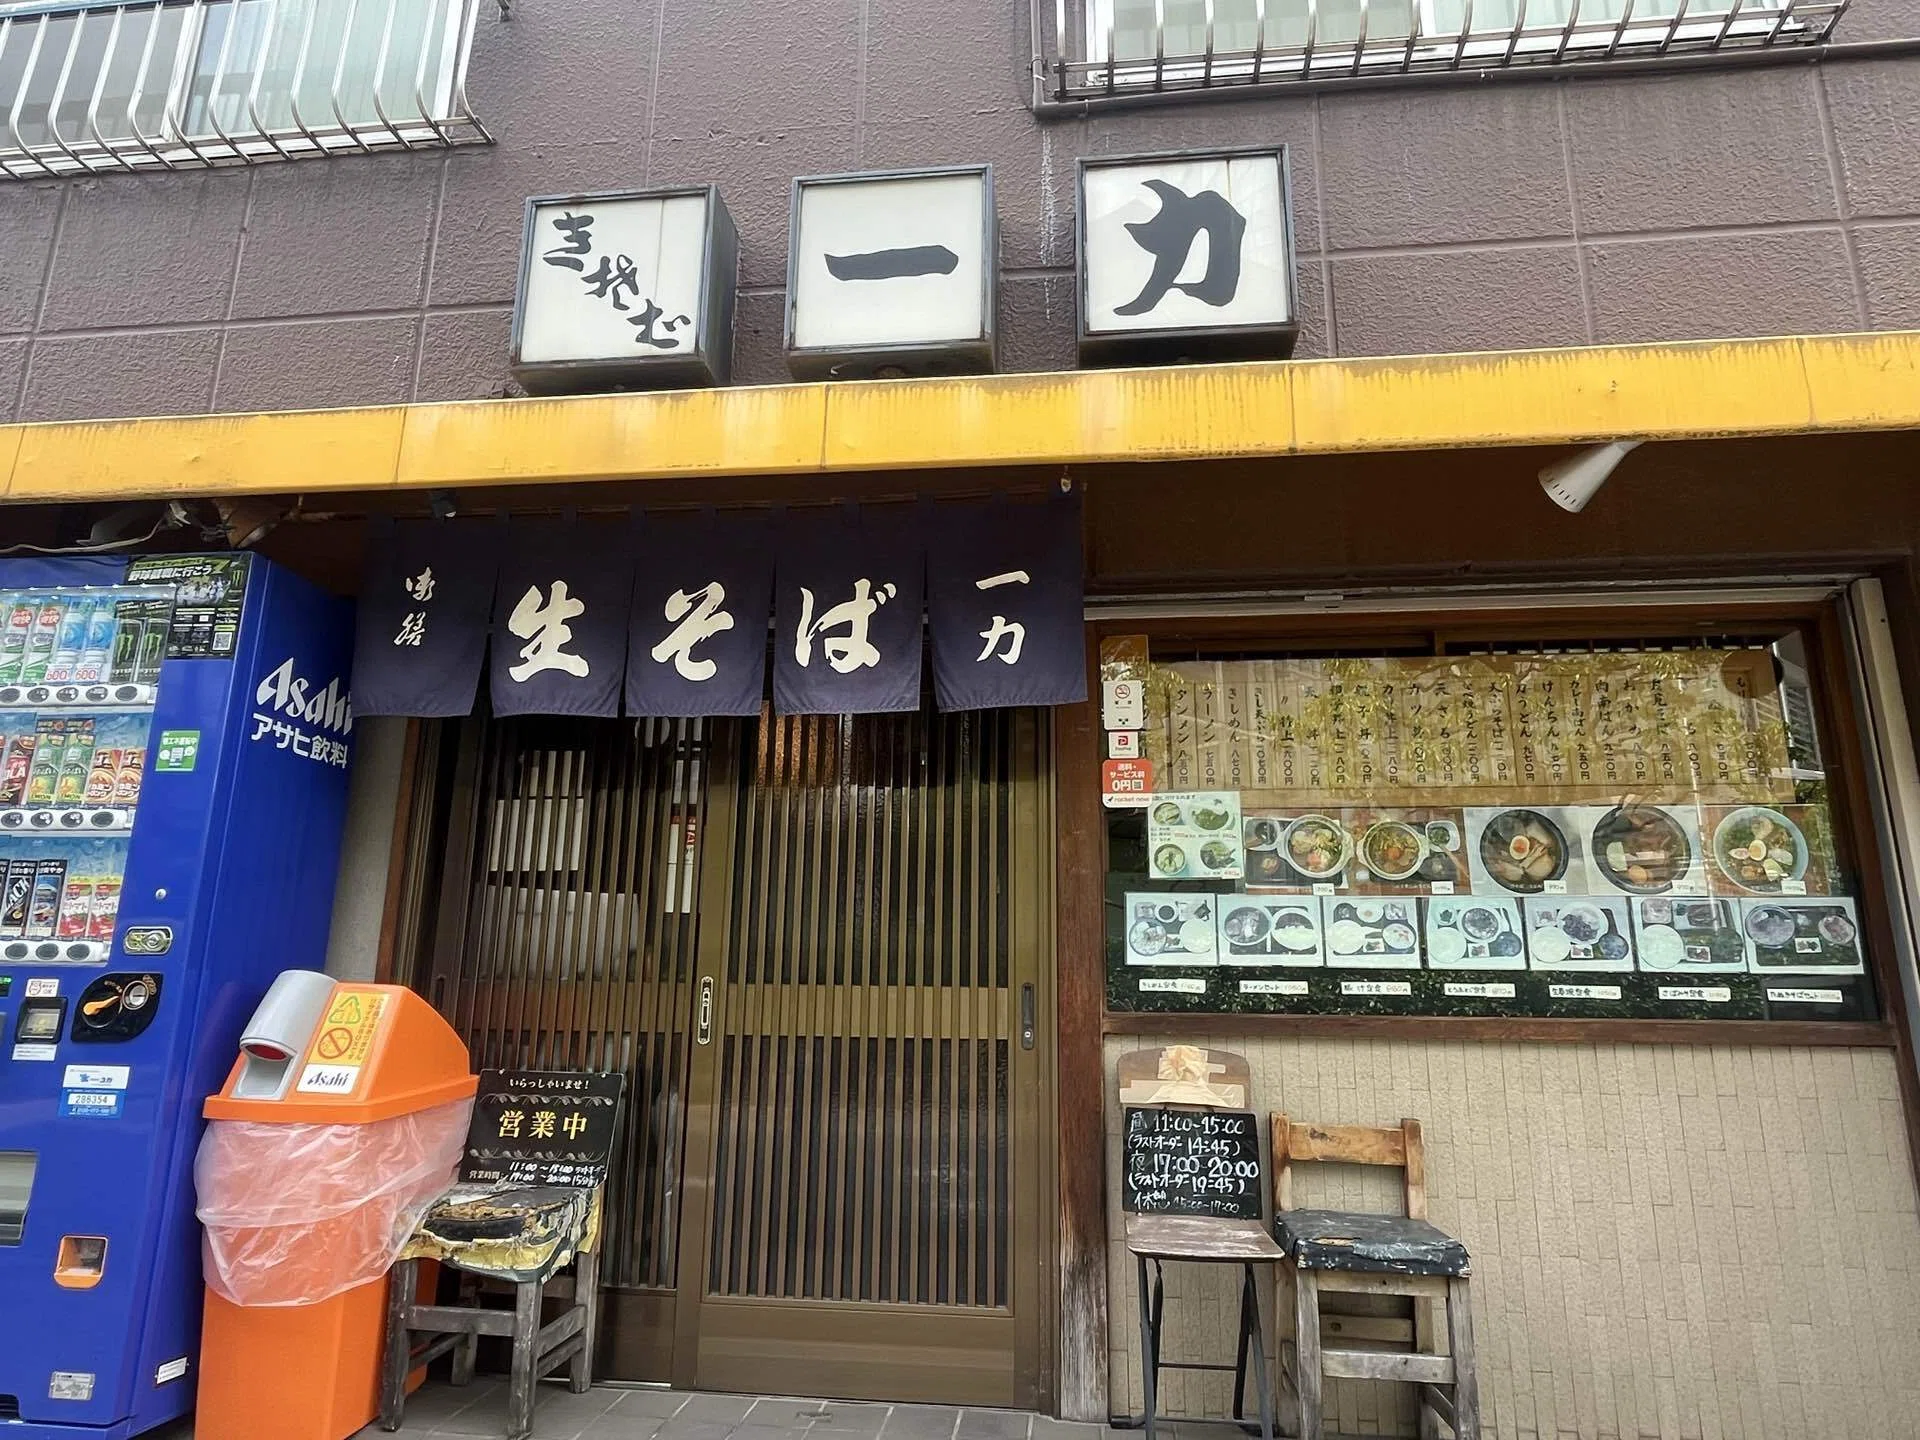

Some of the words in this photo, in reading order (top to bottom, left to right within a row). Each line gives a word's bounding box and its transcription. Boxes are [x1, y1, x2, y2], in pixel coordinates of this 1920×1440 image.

[1112, 179, 1245, 316] 力
[975, 569, 1030, 665] 一力
[256, 657, 352, 736] Asahi
[251, 712, 348, 769] アサヒ飲料
[307, 1071, 351, 1087] Asahi
[498, 1110, 588, 1140] 営業中
[1129, 1112, 1148, 1132] 昼
[1129, 1150, 1145, 1171] 夜
